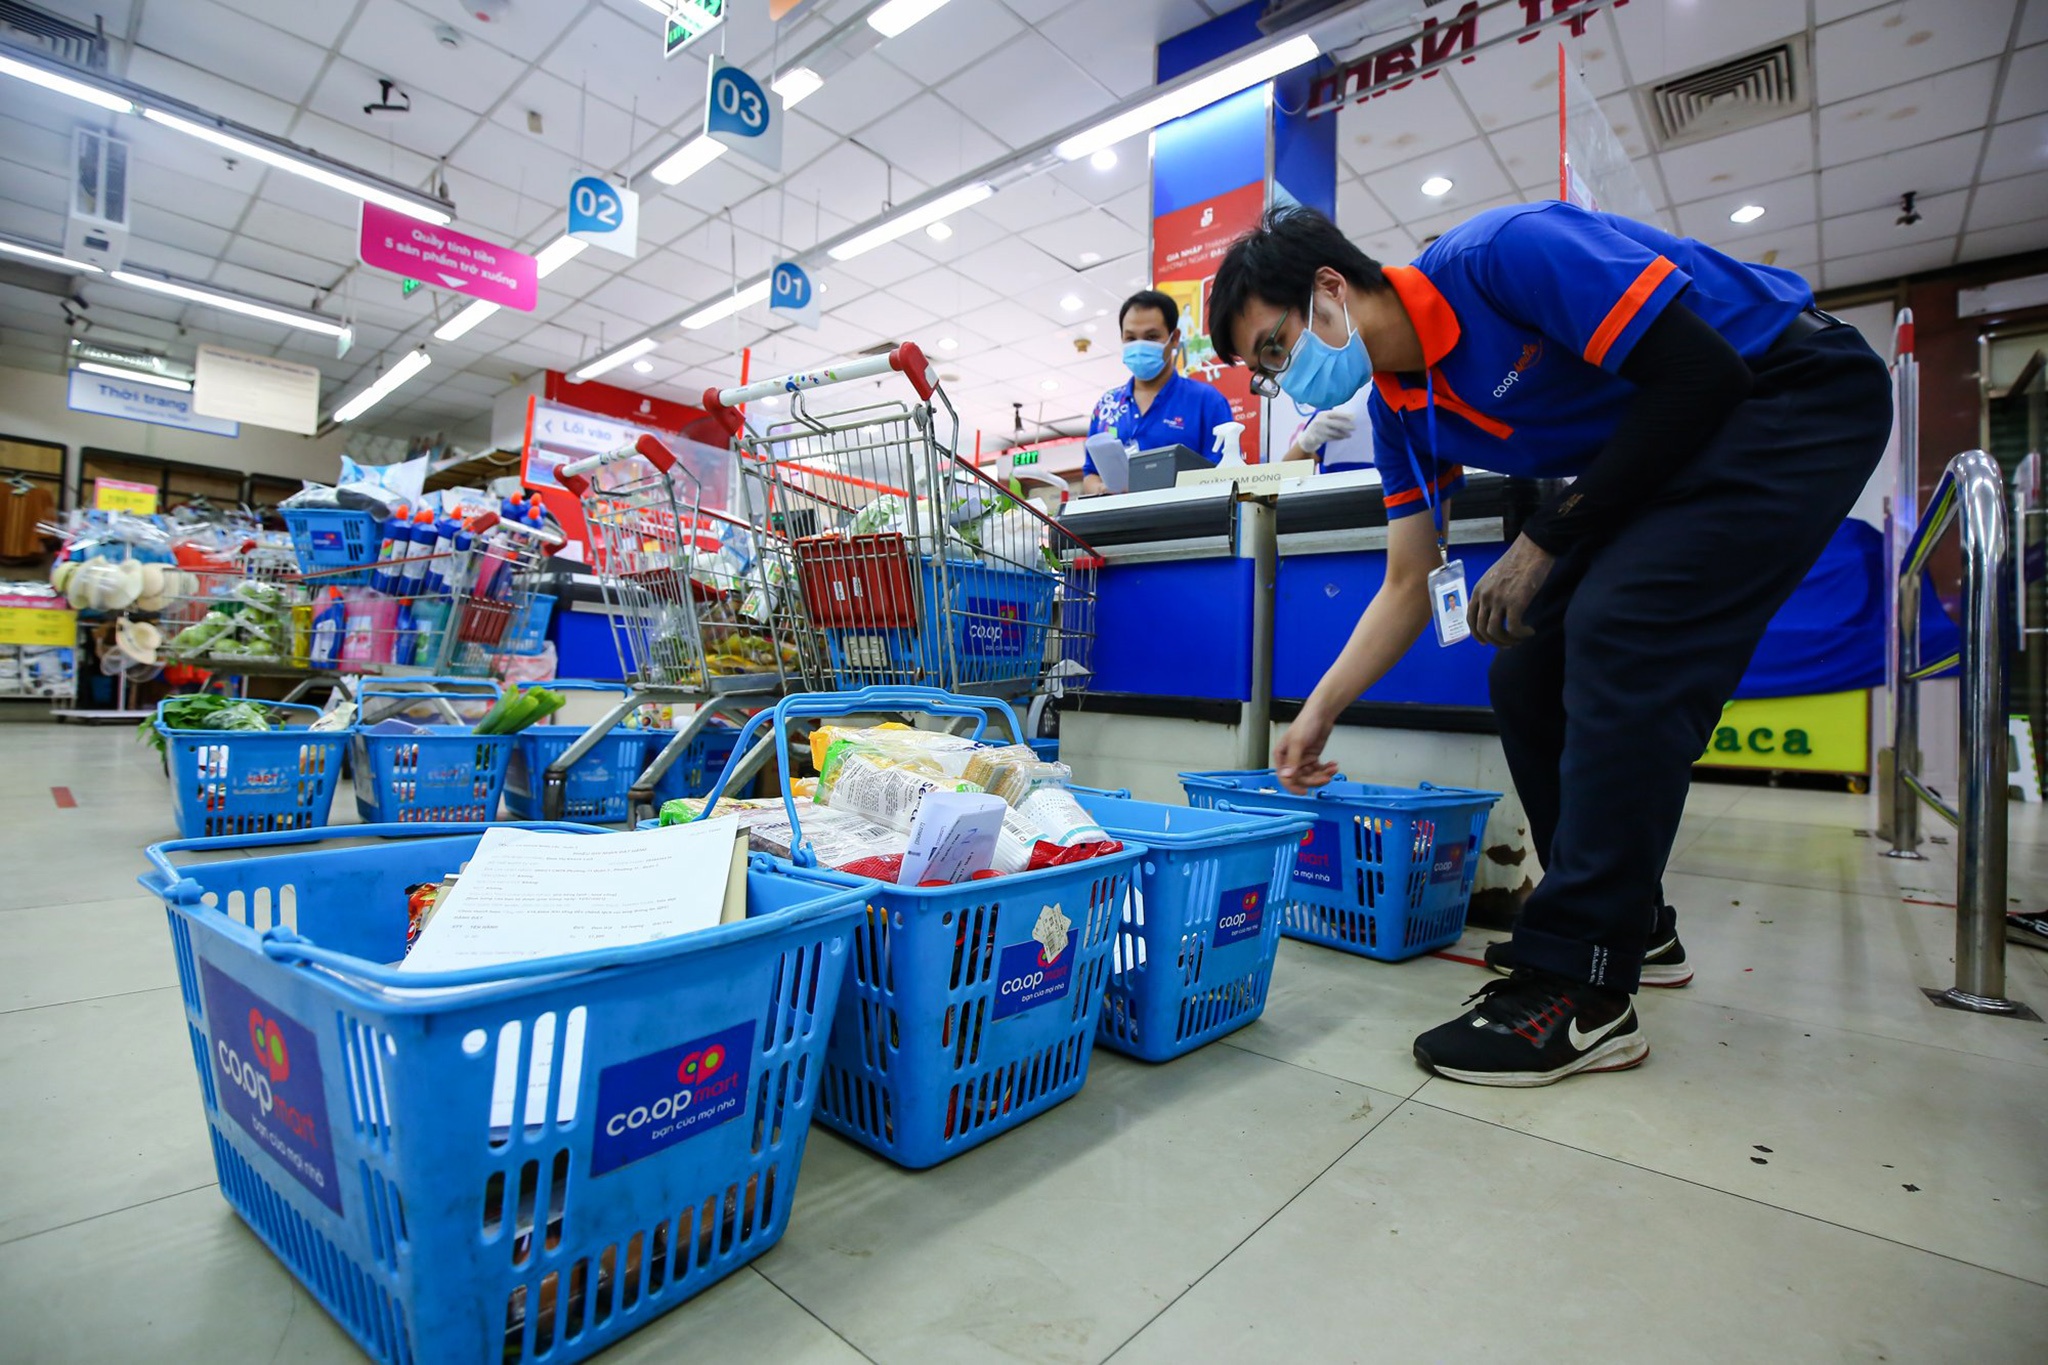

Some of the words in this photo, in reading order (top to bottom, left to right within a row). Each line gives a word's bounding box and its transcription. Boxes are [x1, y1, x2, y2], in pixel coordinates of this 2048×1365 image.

[717, 78, 763, 128] 03
[575, 186, 618, 226] 02
[384, 237, 394, 249] 5
[775, 269, 803, 300] 01
[98, 384, 139, 402] Thời
[144, 394, 189, 413] trang
[562, 420, 584, 434] Lối
[588, 428, 612, 441] vào
[1015, 451, 1039, 466] EXIT
[1702, 726, 1812, 755] aca
[1315, 871, 1330, 882] nhà
[651, 1125, 674, 1140] bạn
[676, 1115, 696, 1130] của
[697, 1107, 716, 1121] mọi
[717, 1097, 736, 1112] nhà
